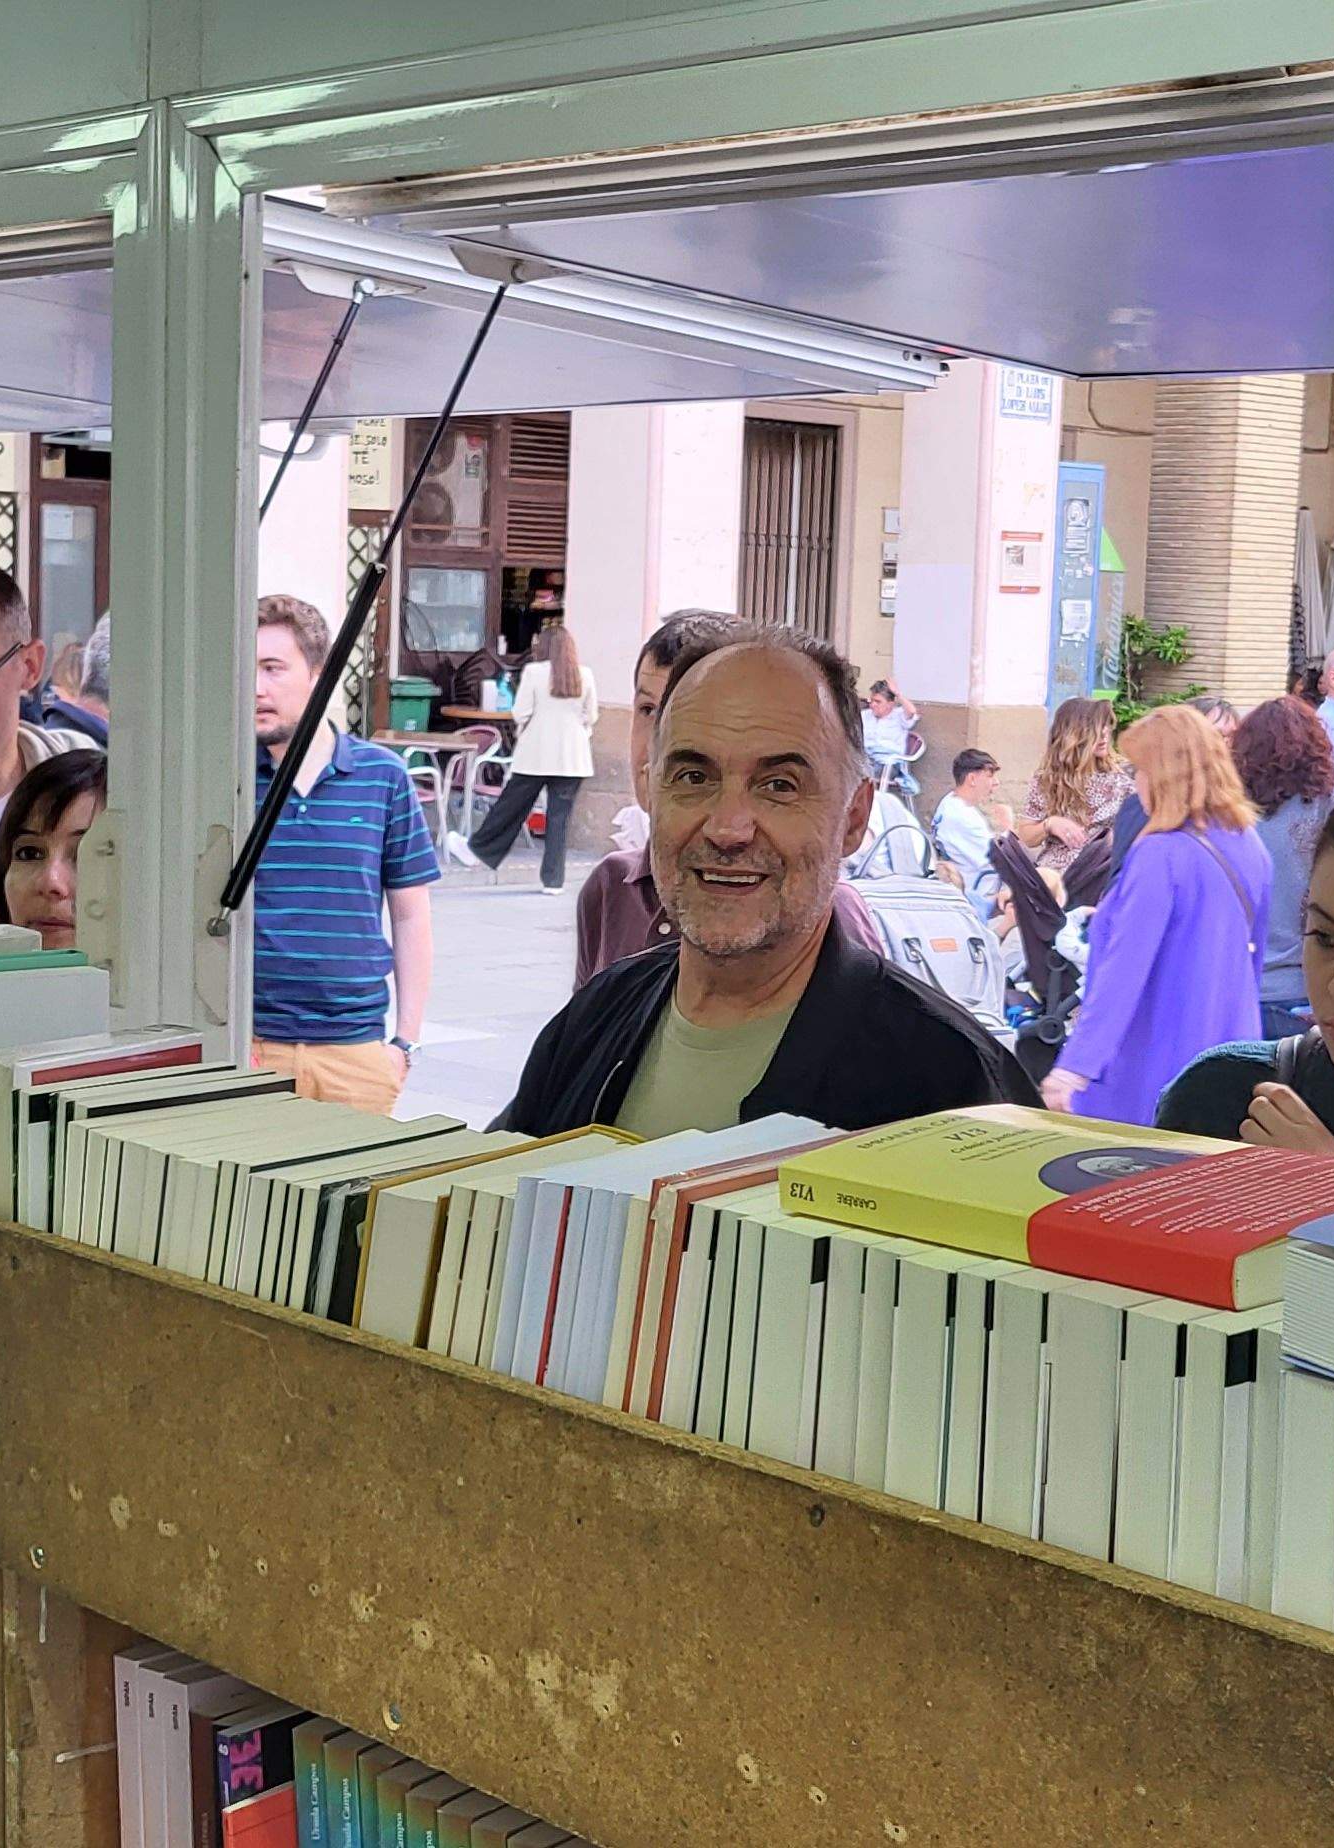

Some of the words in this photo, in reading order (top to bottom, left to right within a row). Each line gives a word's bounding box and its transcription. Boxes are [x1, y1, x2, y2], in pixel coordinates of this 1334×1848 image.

[943, 1128, 989, 1142] V13
[790, 1182, 814, 1202] V13
[309, 1763, 321, 1805] Campos
[341, 1778, 352, 1820] Campos
